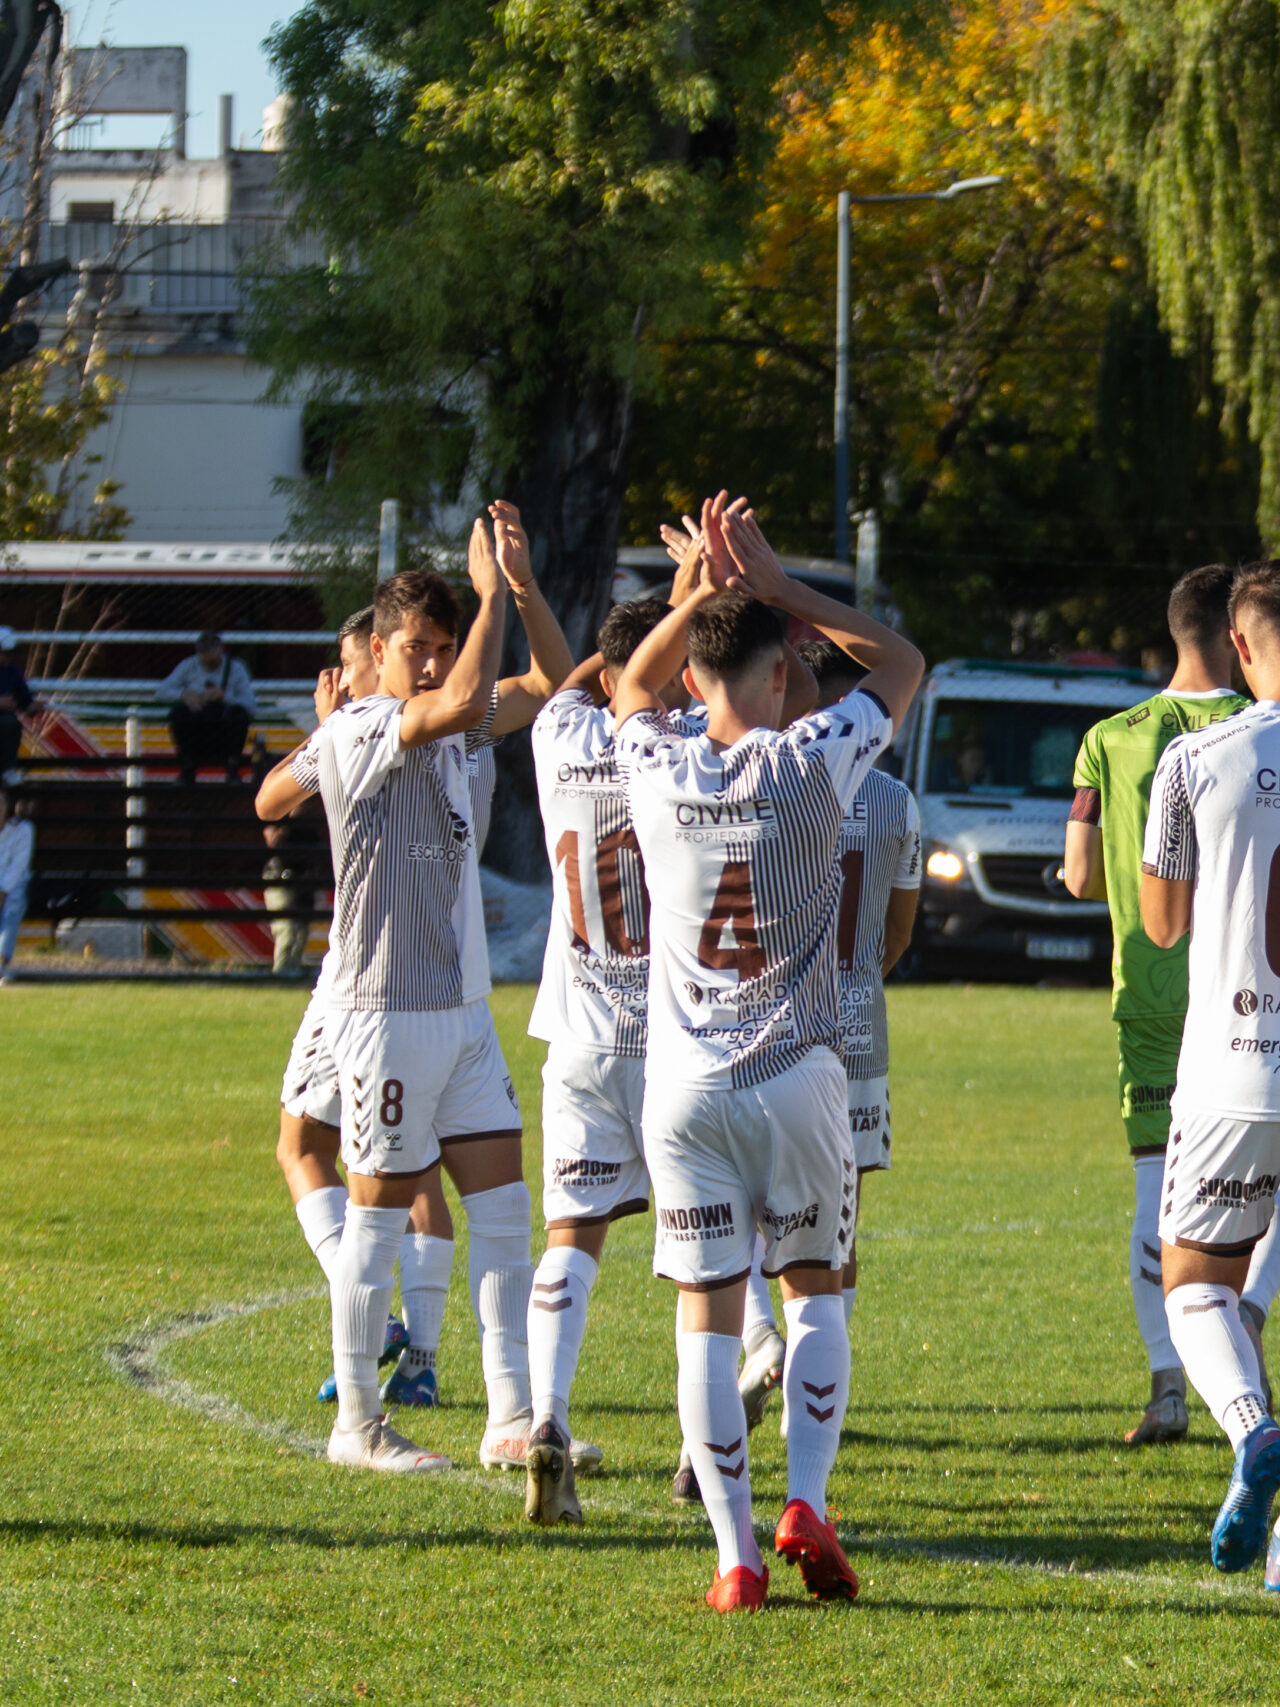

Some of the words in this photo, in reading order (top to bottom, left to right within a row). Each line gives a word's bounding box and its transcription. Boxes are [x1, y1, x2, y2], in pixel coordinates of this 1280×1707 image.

[1201, 724, 1251, 751] PESGRAFICA
[557, 762, 621, 784] CIVIL
[554, 787, 625, 800] PROPIEDAD
[676, 797, 774, 826] CIVILE
[675, 825, 779, 844] PROPIEDADES
[555, 829, 651, 958] 10
[697, 862, 768, 983] 4
[578, 953, 650, 972] RAMAD
[707, 984, 788, 1005] RAMAD
[840, 989, 872, 1003] ADA
[380, 1078, 404, 1127] 8
[851, 1115, 880, 1133] IAN
[1197, 1174, 1278, 1201] SUNDOWN
[699, 1226, 735, 1241] TOLDOS
